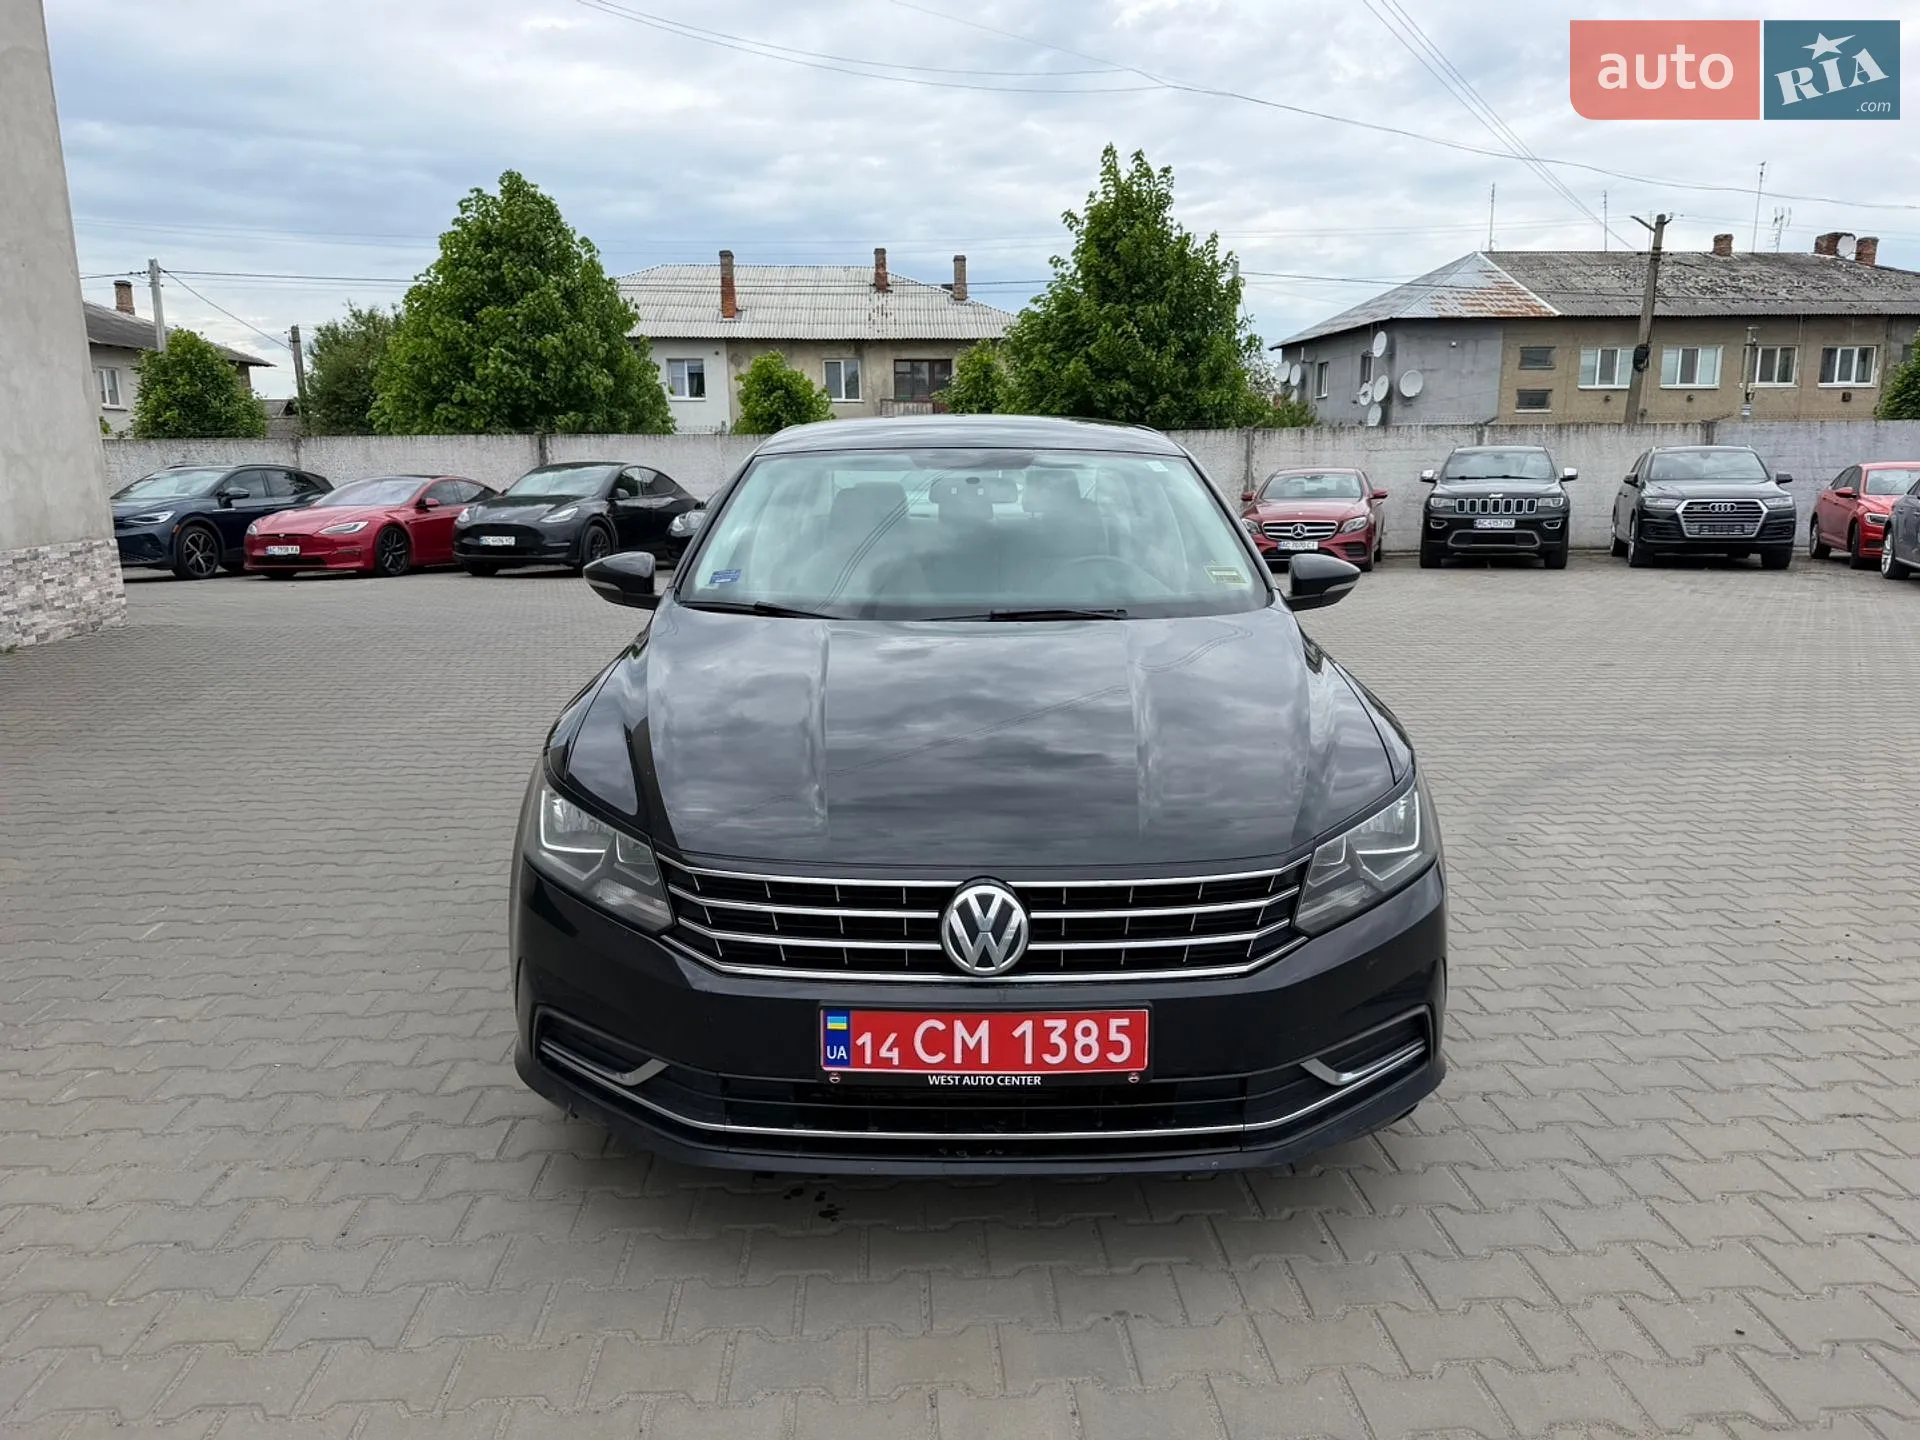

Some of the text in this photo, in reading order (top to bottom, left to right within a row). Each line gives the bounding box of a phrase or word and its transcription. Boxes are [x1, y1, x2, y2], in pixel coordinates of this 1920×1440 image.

[855, 1018, 1132, 1066] 14 CM 1385
[826, 1045, 848, 1060] UA
[928, 1075, 1042, 1087] WEST AUTO CENTER
